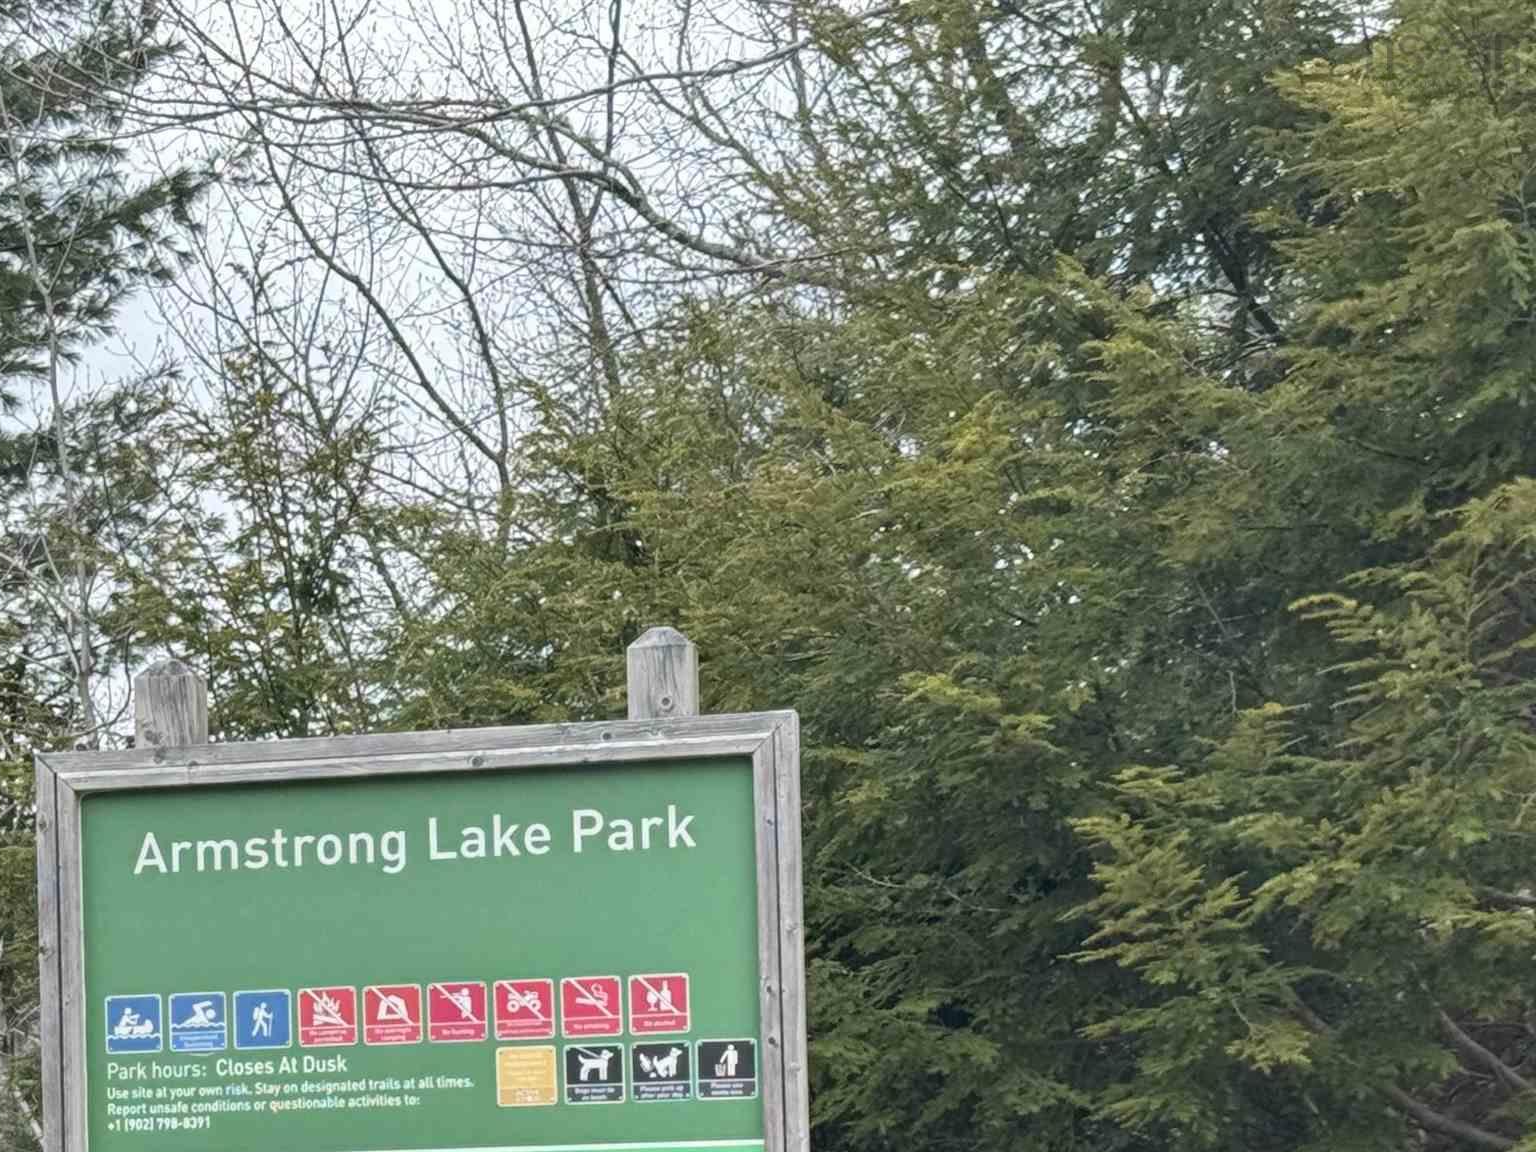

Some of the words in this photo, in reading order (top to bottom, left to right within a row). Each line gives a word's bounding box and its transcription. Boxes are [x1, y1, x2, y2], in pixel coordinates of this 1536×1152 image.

[133, 827, 407, 875] Armstrong
[428, 813, 552, 861] Lake
[572, 804, 697, 853] Park
[107, 1061, 147, 1080] Park
[152, 1061, 207, 1079] hours:
[216, 1058, 274, 1077] Closes
[278, 1056, 298, 1073] At
[303, 1054, 348, 1073] Dusk
[107, 1087, 129, 1100] Use
[131, 1086, 153, 1099] site
[155, 1086, 167, 1098] at
[169, 1086, 196, 1101] your
[198, 1085, 223, 1097] own
[225, 1083, 253, 1096] risk.
[254, 1082, 281, 1098] Stay
[282, 1083, 298, 1094] on
[300, 1078, 366, 1095] designated
[368, 1076, 401, 1091] trails
[403, 1077, 415, 1090] at
[418, 1075, 434, 1089] all
[436, 1075, 475, 1089] times.
[107, 1102, 146, 1117] Report
[149, 1101, 189, 1114] unsafe
[191, 1099, 251, 1113] conditions
[253, 1100, 266, 1111] or
[269, 1095, 346, 1115] questionable
[348, 1094, 402, 1108] activities
[404, 1094, 421, 1106] to:
[107, 1117, 121, 1132] +1
[124, 1117, 154, 1132] (902)
